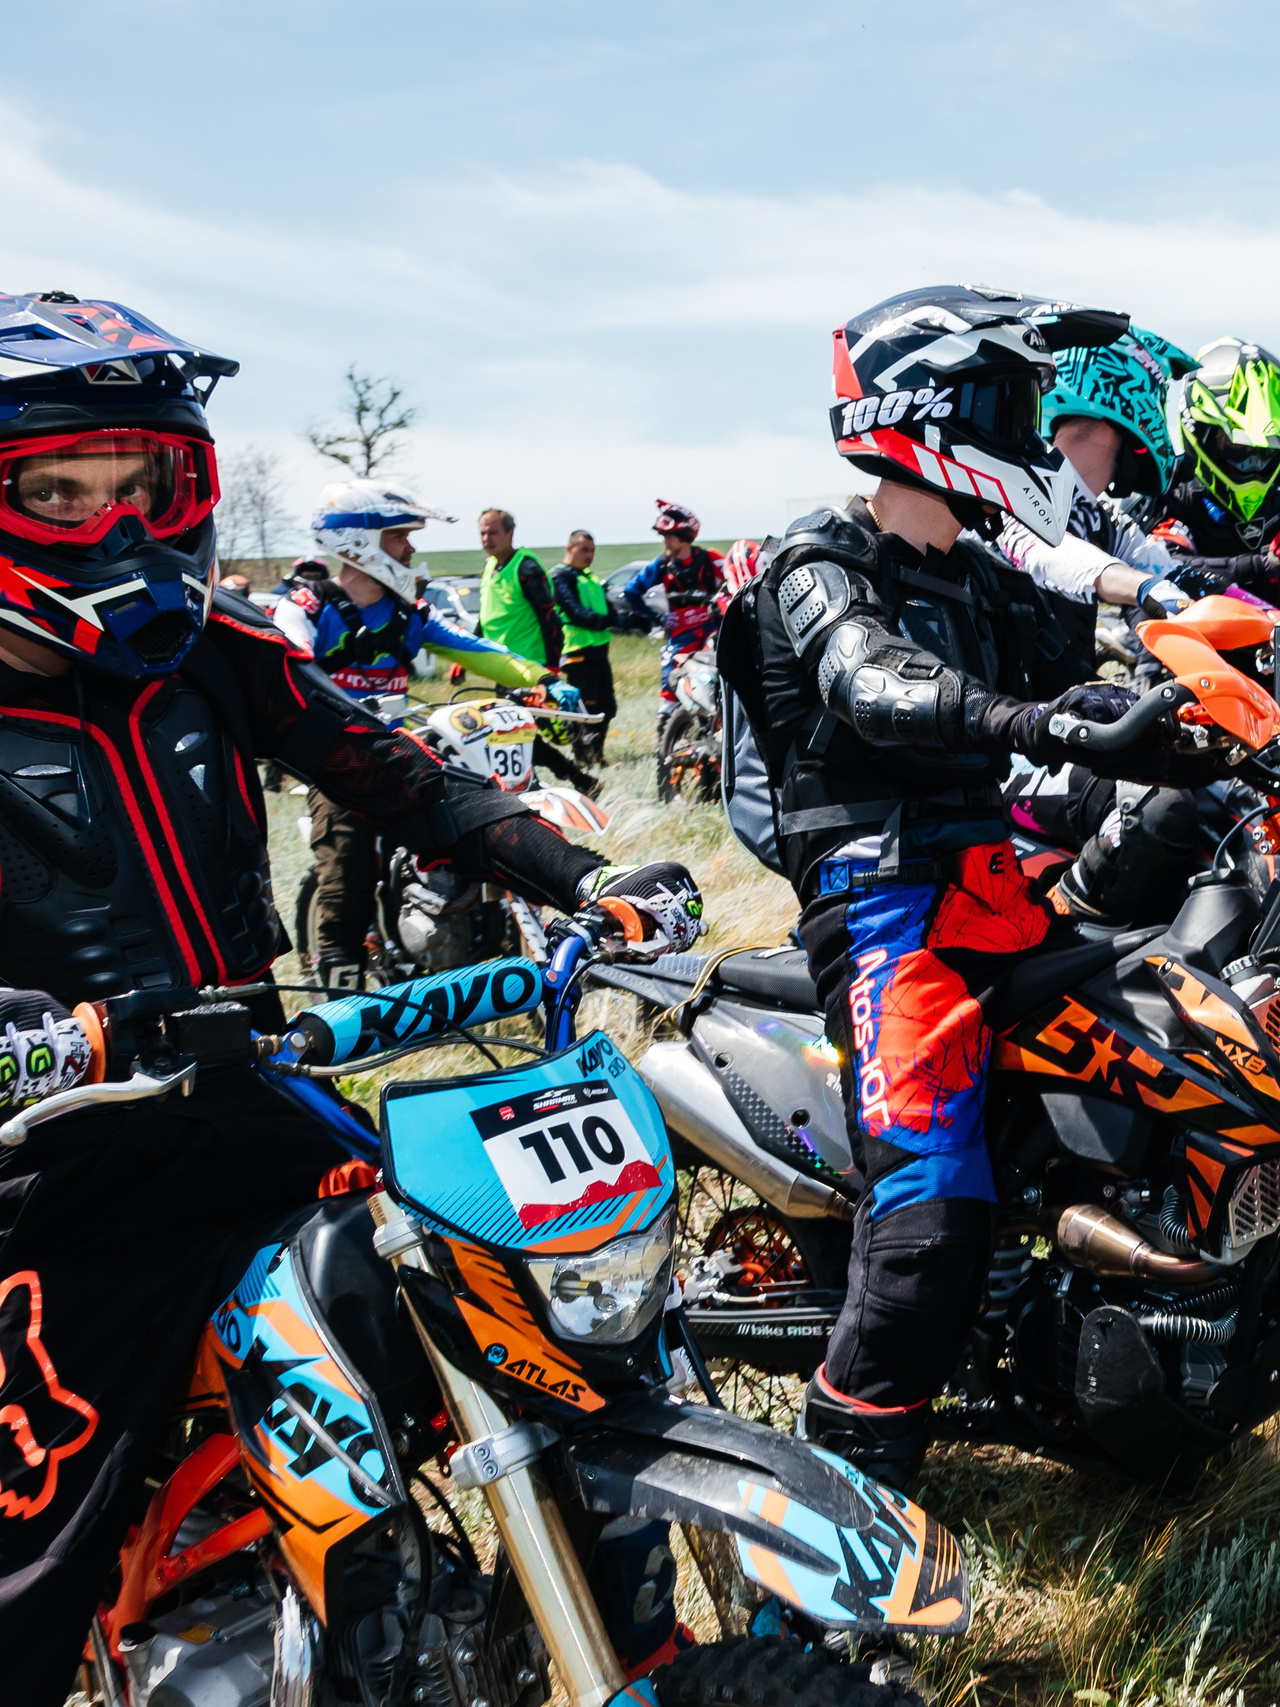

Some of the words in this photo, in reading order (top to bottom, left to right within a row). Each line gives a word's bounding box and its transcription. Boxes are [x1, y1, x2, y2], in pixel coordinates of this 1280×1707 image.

[841, 386, 955, 436] 100%
[1022, 486, 1052, 527] AIROH
[494, 749, 522, 777] 36
[348, 967, 536, 1059] KAYO
[576, 1039, 613, 1079] KAYO
[518, 1115, 625, 1184] 110
[503, 1358, 587, 1402] ATLAS
